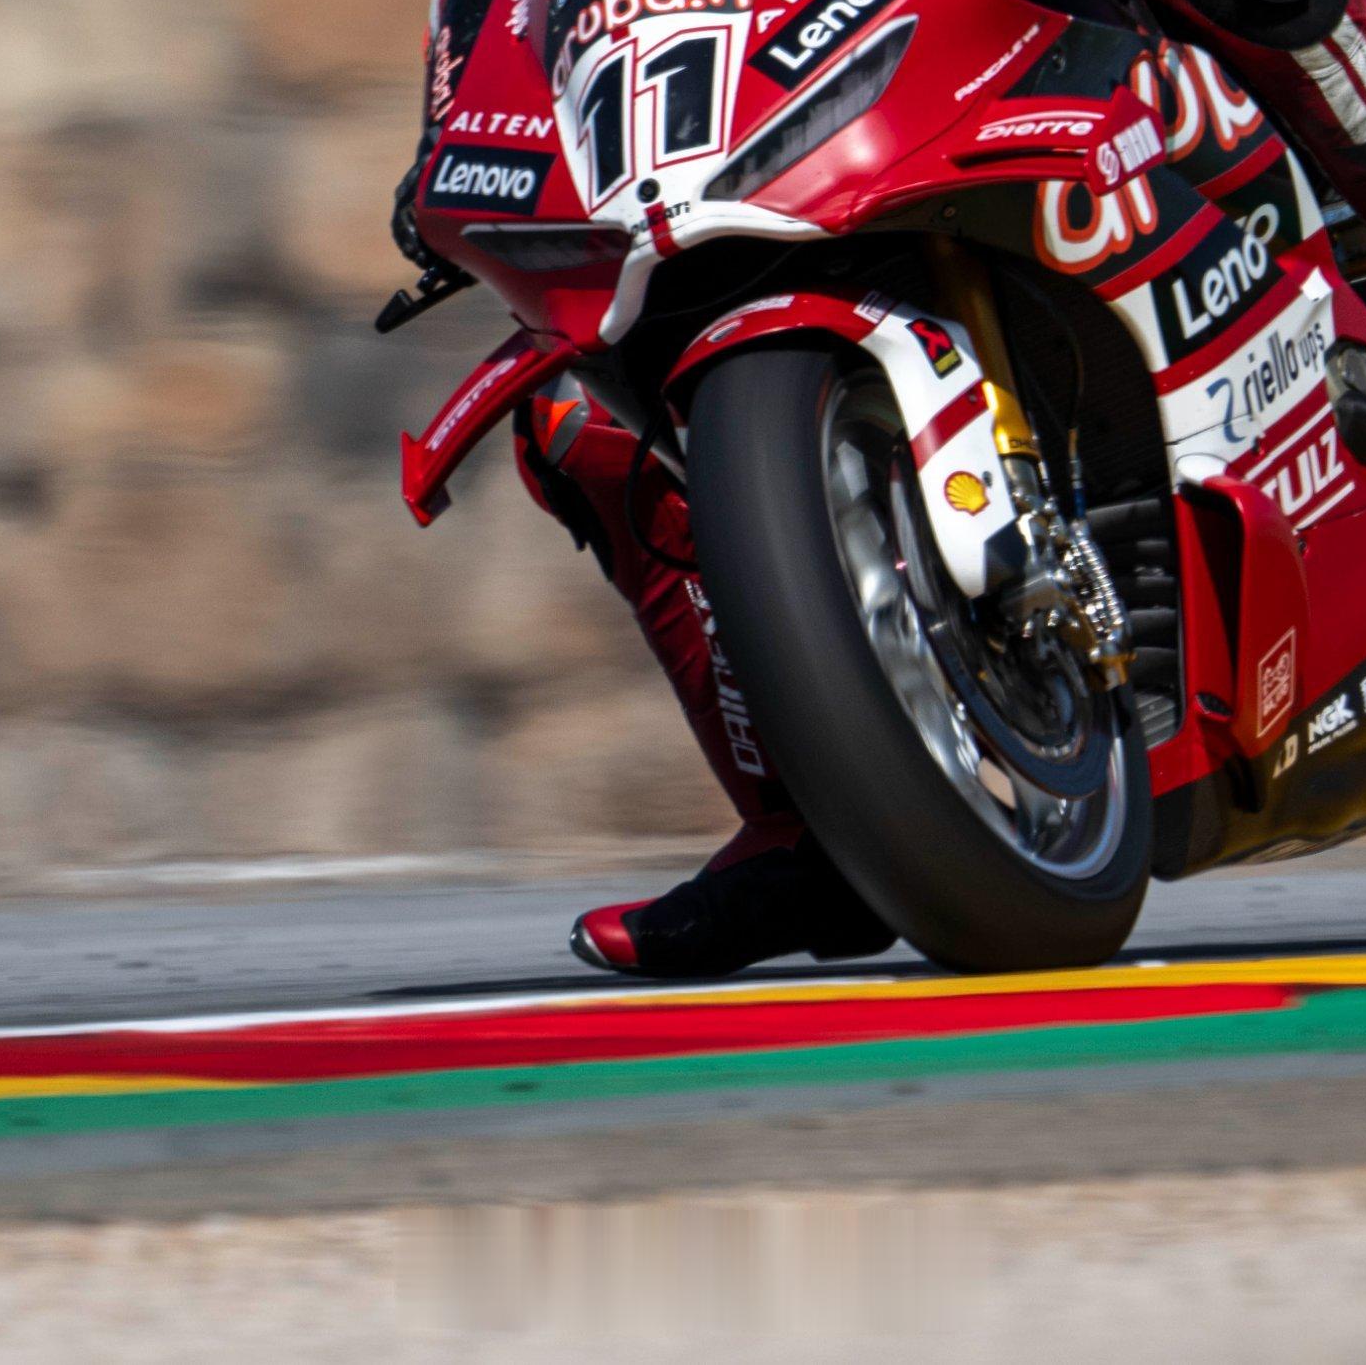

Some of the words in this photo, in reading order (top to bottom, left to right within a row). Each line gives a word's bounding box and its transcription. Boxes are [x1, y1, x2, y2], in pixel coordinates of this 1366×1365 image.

[447, 109, 554, 140] ALTEN
[577, 27, 731, 211] 11
[975, 120, 1094, 143] Dierre
[435, 154, 537, 200] Lenovo
[1243, 330, 1299, 422] riello
[1298, 322, 1326, 373] ups
[1308, 692, 1356, 743] NGK
